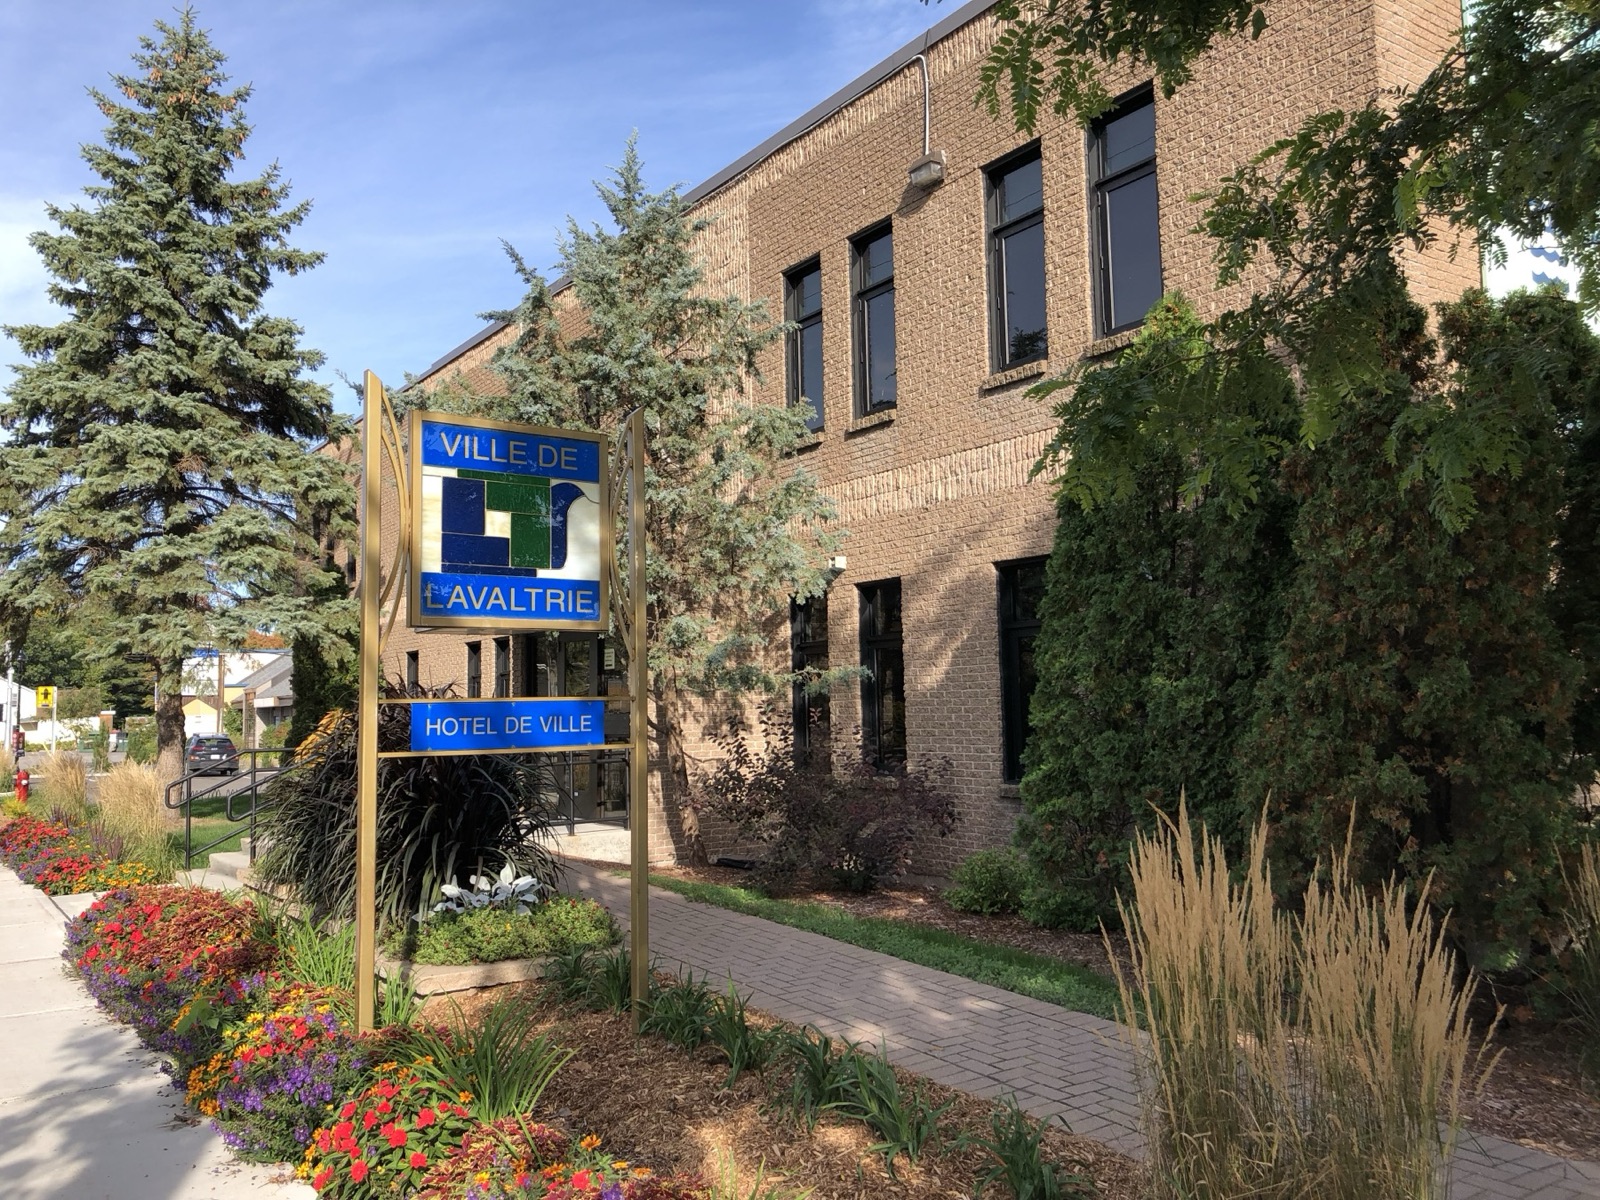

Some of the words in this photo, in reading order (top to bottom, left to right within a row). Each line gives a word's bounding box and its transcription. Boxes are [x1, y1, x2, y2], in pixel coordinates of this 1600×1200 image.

[440, 432, 526, 465] VILLE
[538, 444, 578, 471] DE
[426, 583, 593, 613] LAVALTRIE
[426, 717, 497, 736] HOTEL
[505, 716, 532, 734] DE
[540, 715, 592, 733] VILLE
